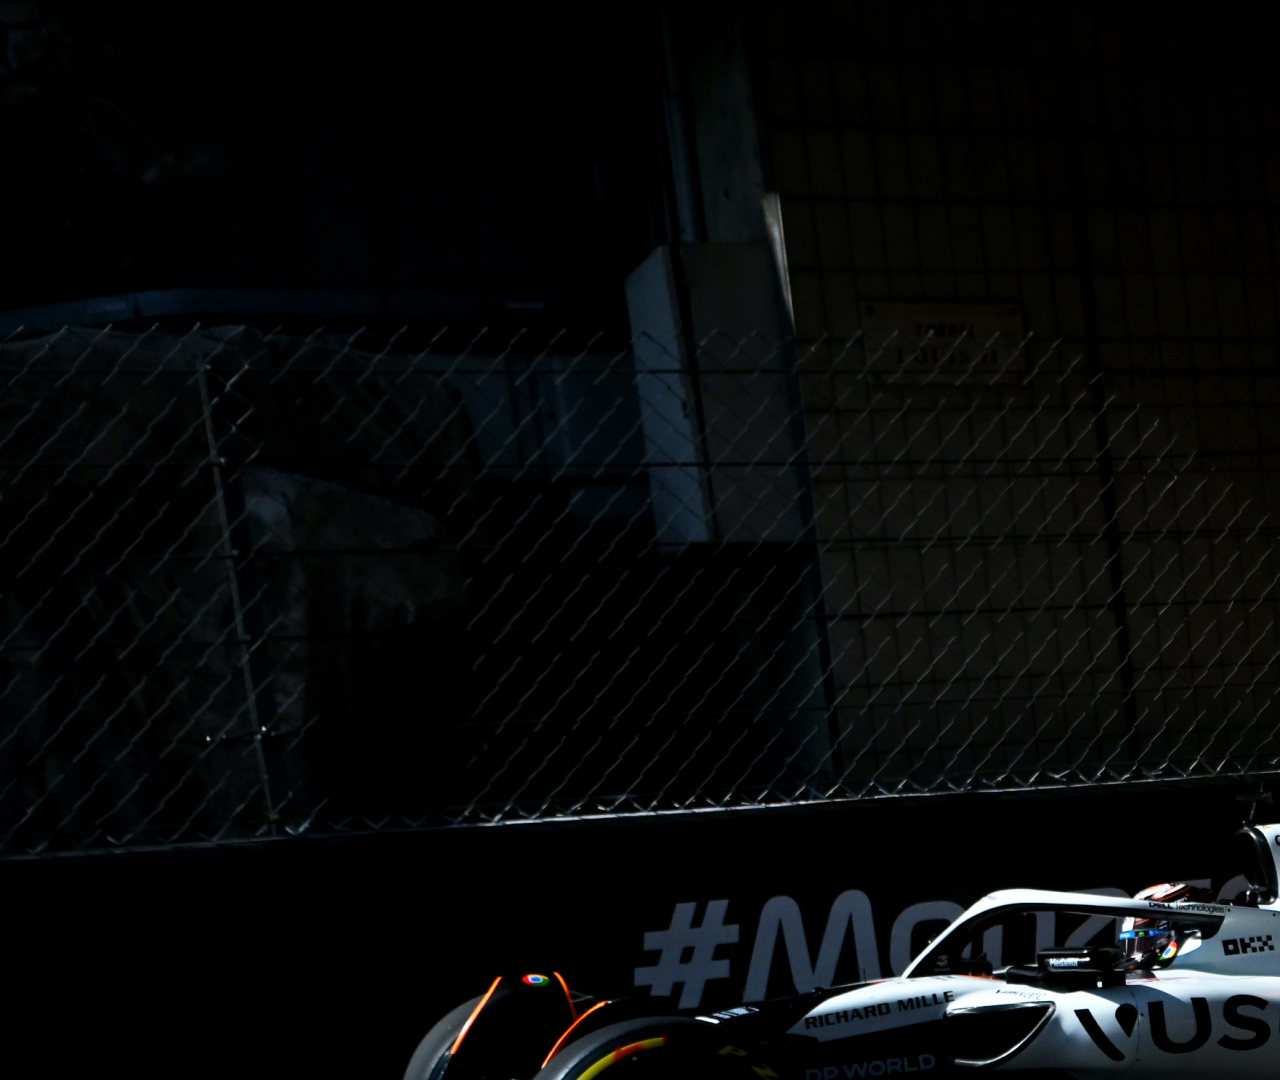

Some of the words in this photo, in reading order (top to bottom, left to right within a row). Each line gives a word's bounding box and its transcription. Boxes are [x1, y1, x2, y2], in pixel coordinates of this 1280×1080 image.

[1221, 934, 1276, 957] OKX
[804, 1001, 891, 1030] RICHARD
[898, 990, 955, 1012] MILLE
[842, 1052, 937, 1080] WORLD
